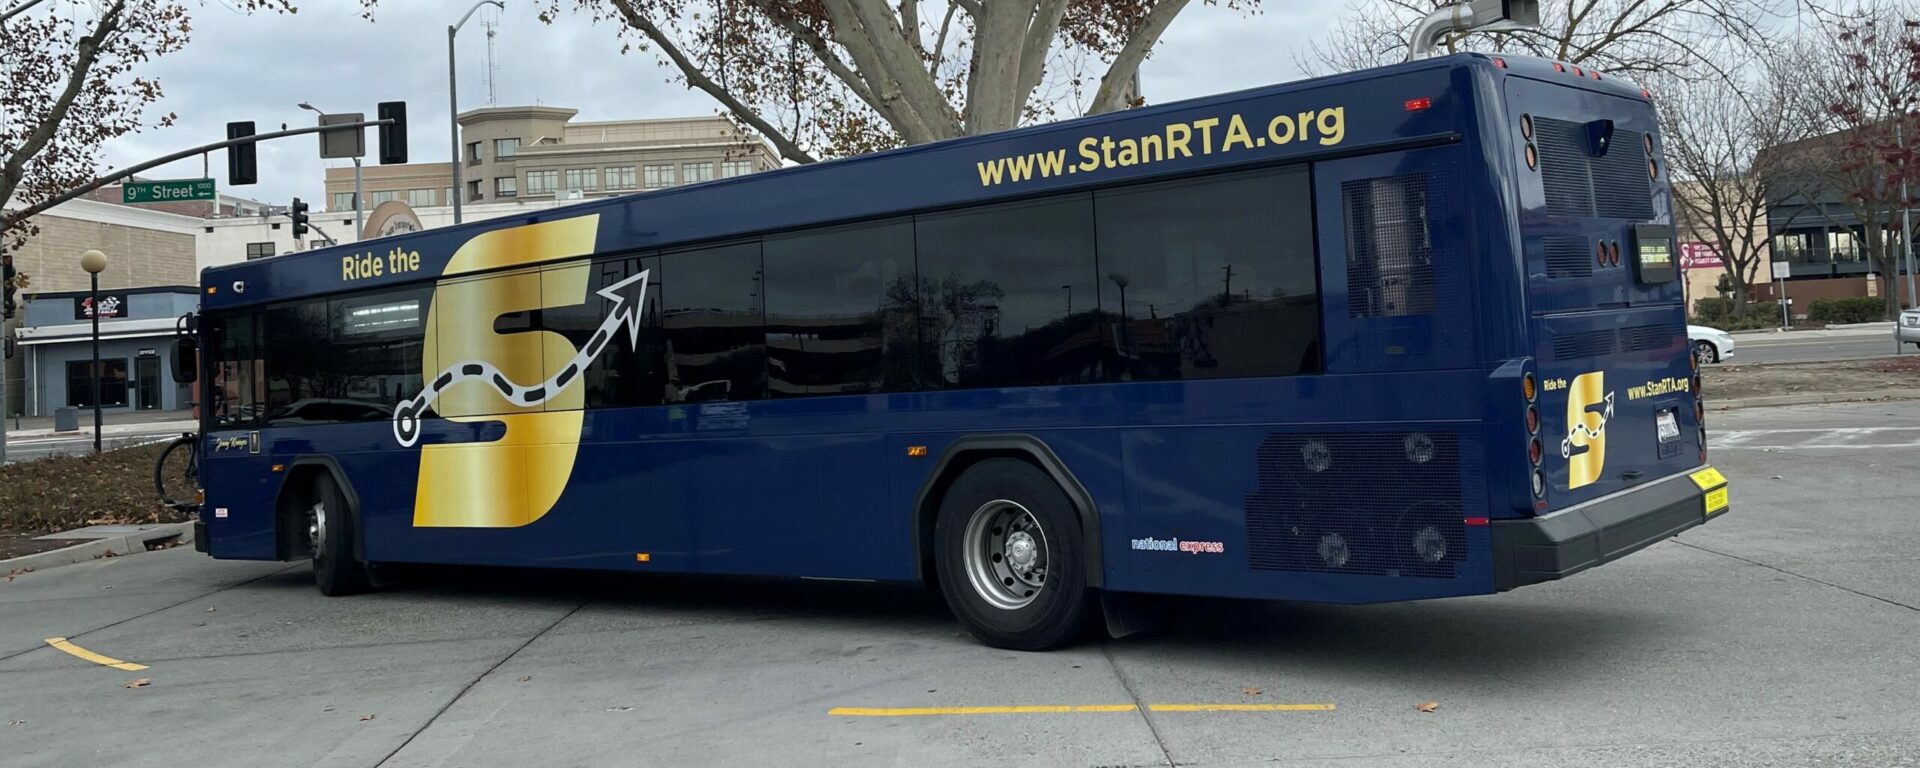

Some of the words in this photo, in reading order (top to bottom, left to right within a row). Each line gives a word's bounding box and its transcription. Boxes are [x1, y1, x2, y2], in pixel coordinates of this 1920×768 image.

[977, 106, 1345, 187] www.StanRTA.org
[152, 184, 194, 199] Street
[342, 252, 384, 281] Ride
[388, 246, 420, 274] the
[1543, 378, 1557, 391] Ride
[1557, 377, 1567, 389] the
[1627, 376, 1689, 401] www.StanRTA.org
[1131, 537, 1178, 551] national
[1179, 540, 1224, 554] express
